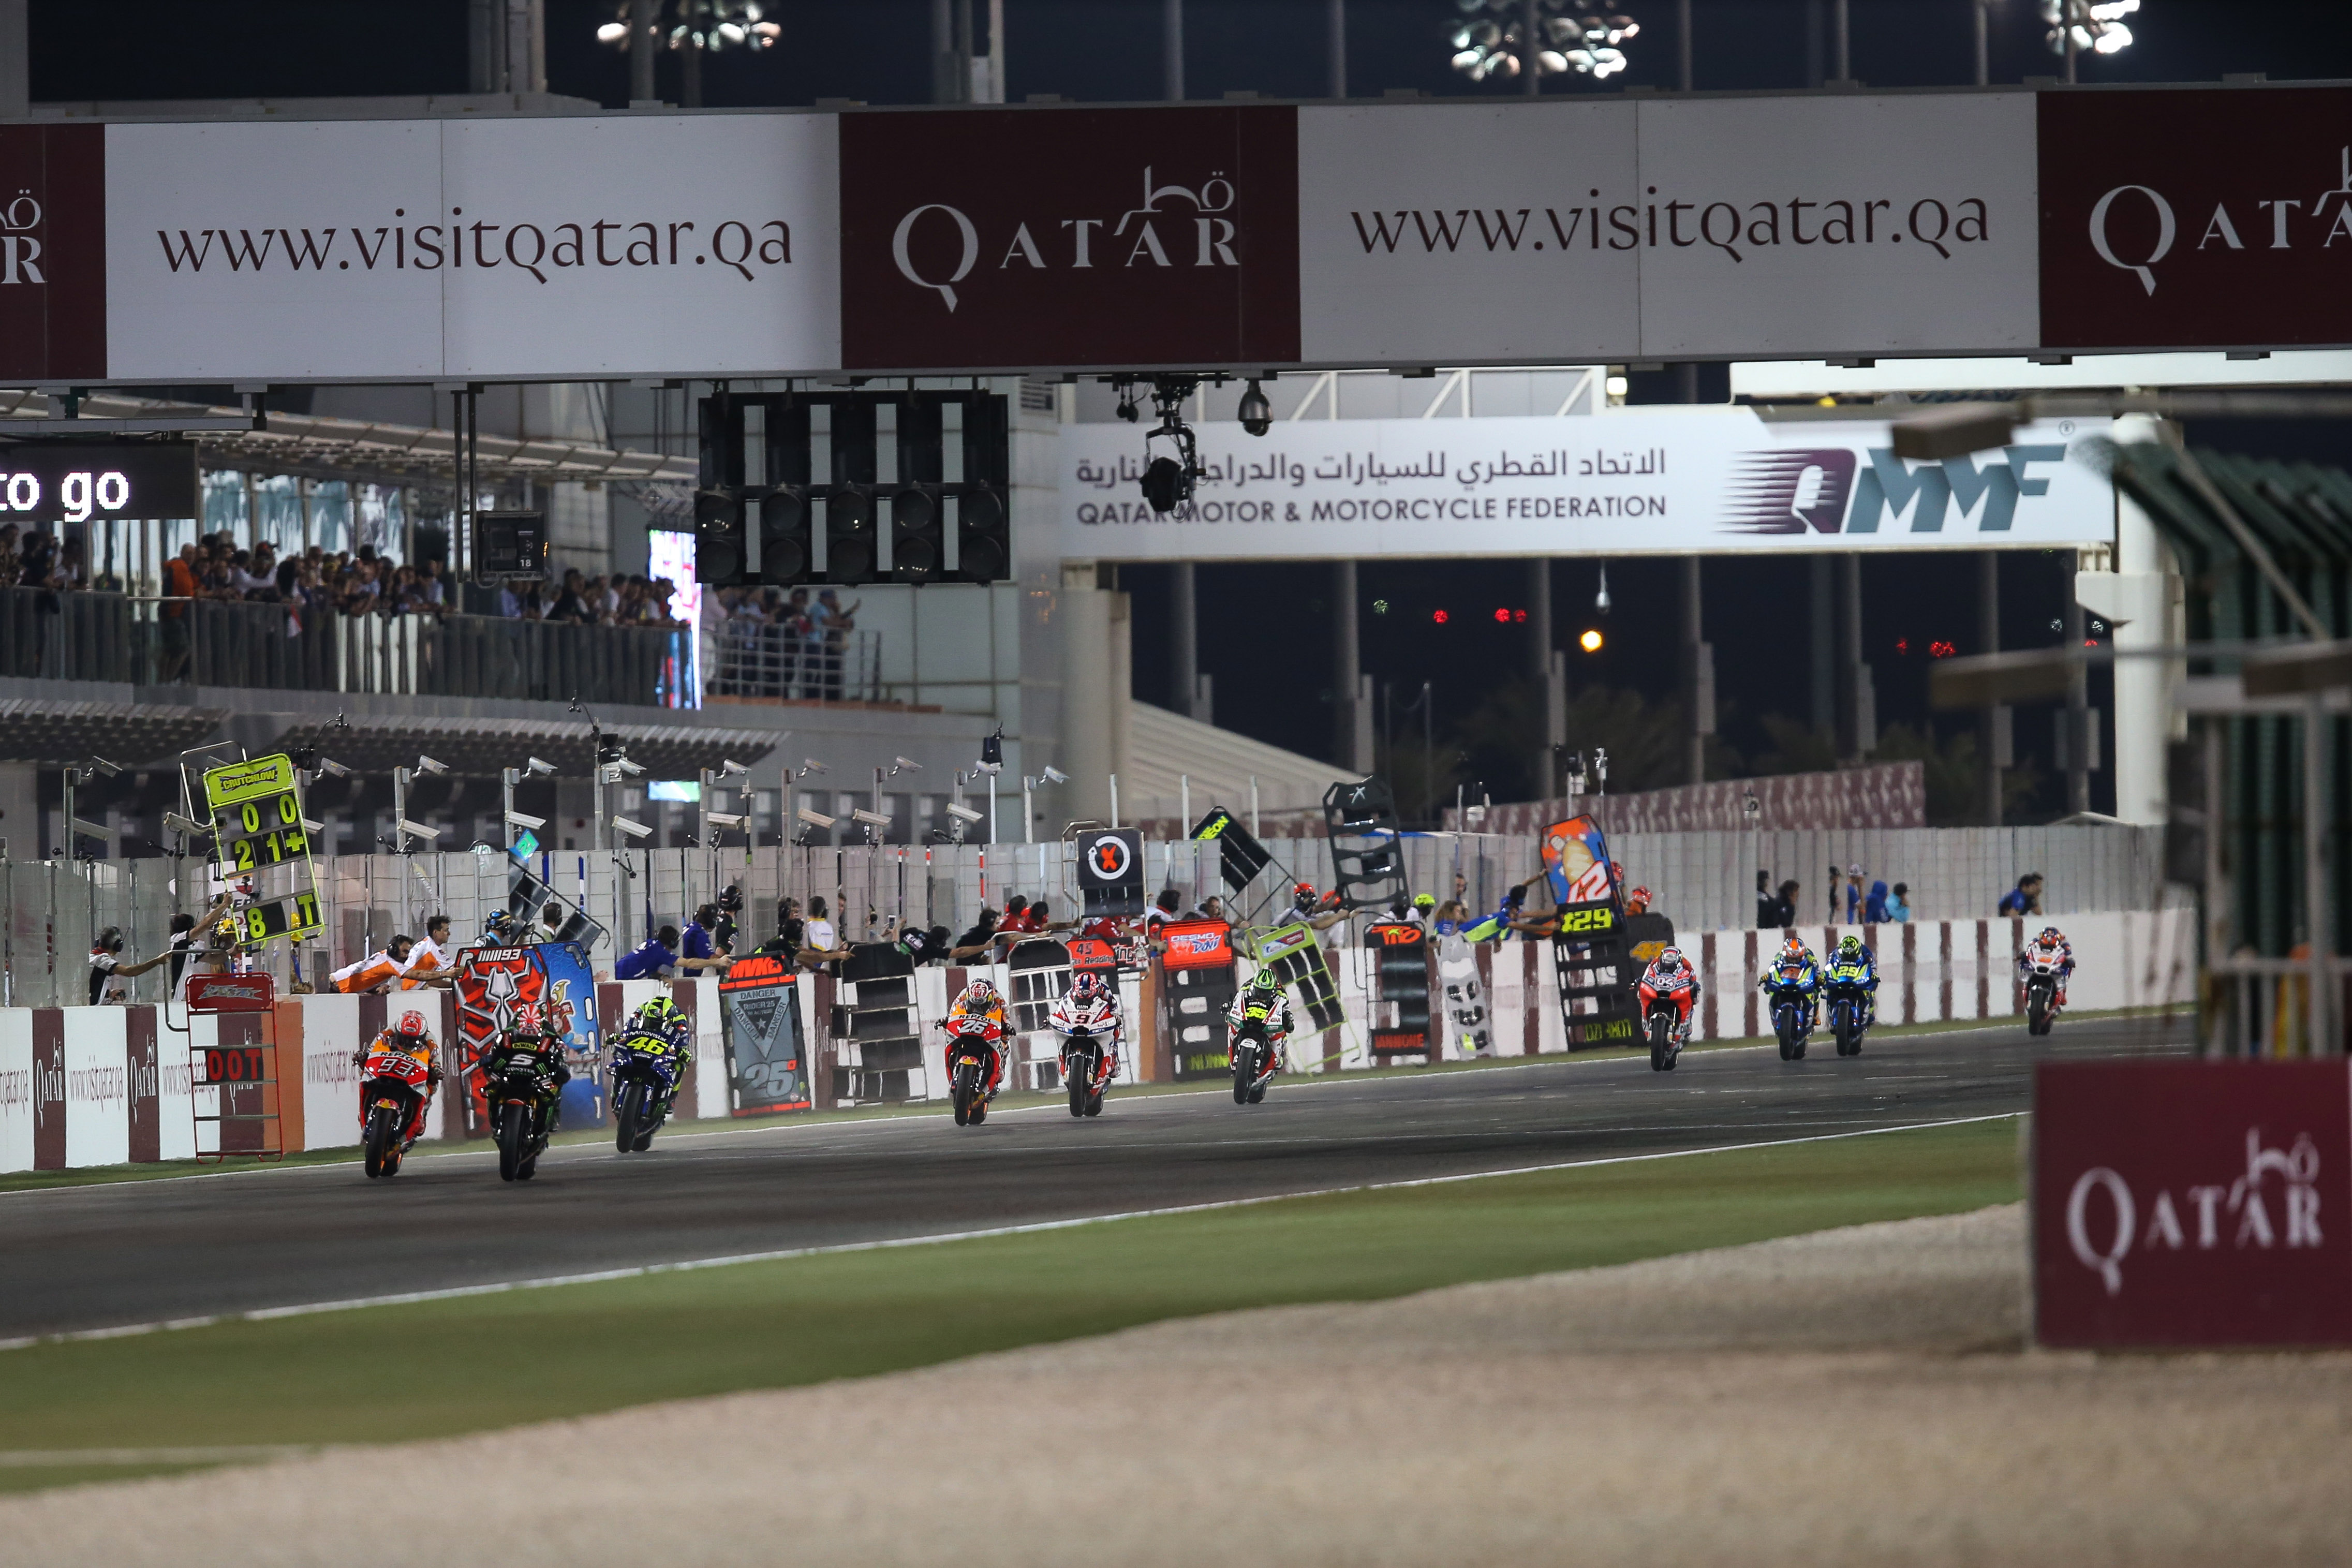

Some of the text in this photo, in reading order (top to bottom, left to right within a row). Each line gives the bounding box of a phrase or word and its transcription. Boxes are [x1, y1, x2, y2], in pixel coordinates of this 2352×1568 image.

[892, 204, 1240, 313] QATAR
[61, 471, 129, 523] go
[1285, 501, 1300, 521] &
[1312, 498, 1497, 521] MOTORCYCLE
[1506, 495, 1666, 519] FEDERATION
[222, 770, 276, 790] CRUTCHLOW
[1171, 932, 1215, 942] DESMO
[1076, 942, 1093, 955] 45
[1084, 955, 1116, 966] Redding
[1837, 966, 1859, 977] 29
[1656, 977, 1675, 988] 04
[740, 989, 776, 1000] DANGER
[767, 1001, 787, 1038] DANGER
[958, 1014, 992, 1023] REPSOL
[1075, 1014, 1091, 1024] 9
[1245, 1007, 1268, 1019] 35
[958, 1019, 989, 1034] 26
[626, 1037, 669, 1055] 46
[380, 1052, 417, 1063] REPSOL
[377, 1058, 415, 1078] 93
[741, 1059, 798, 1099] 25
[37, 1059, 63, 1129] QATAR
[130, 1056, 156, 1124] QATAR
[2066, 1166, 2324, 1295] QATAR
